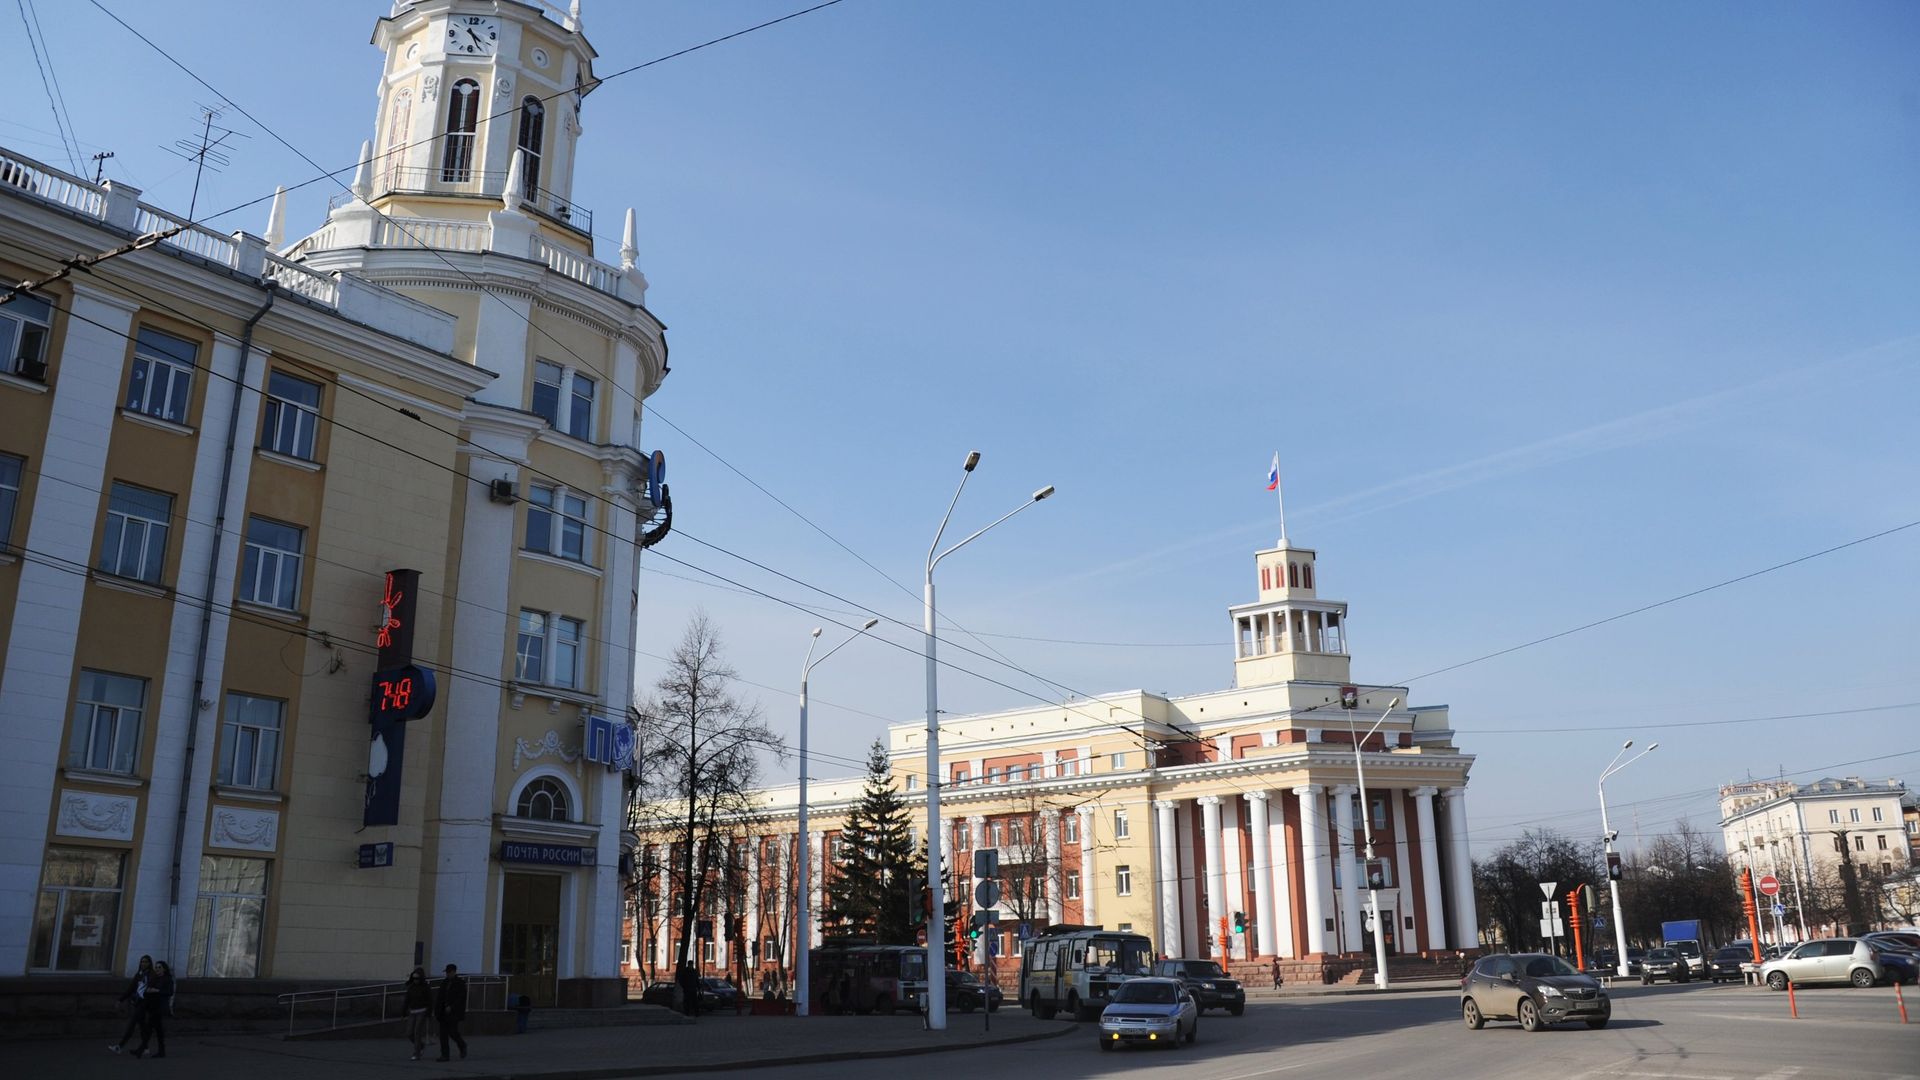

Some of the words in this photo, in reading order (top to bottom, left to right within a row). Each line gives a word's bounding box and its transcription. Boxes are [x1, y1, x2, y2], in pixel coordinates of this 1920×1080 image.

[468, 17, 480, 25] 12
[489, 32, 496, 40] 3
[466, 45, 474, 53] 6
[506, 845, 539, 860] ПОЧТА
[542, 848, 580, 862] РОССИИ
